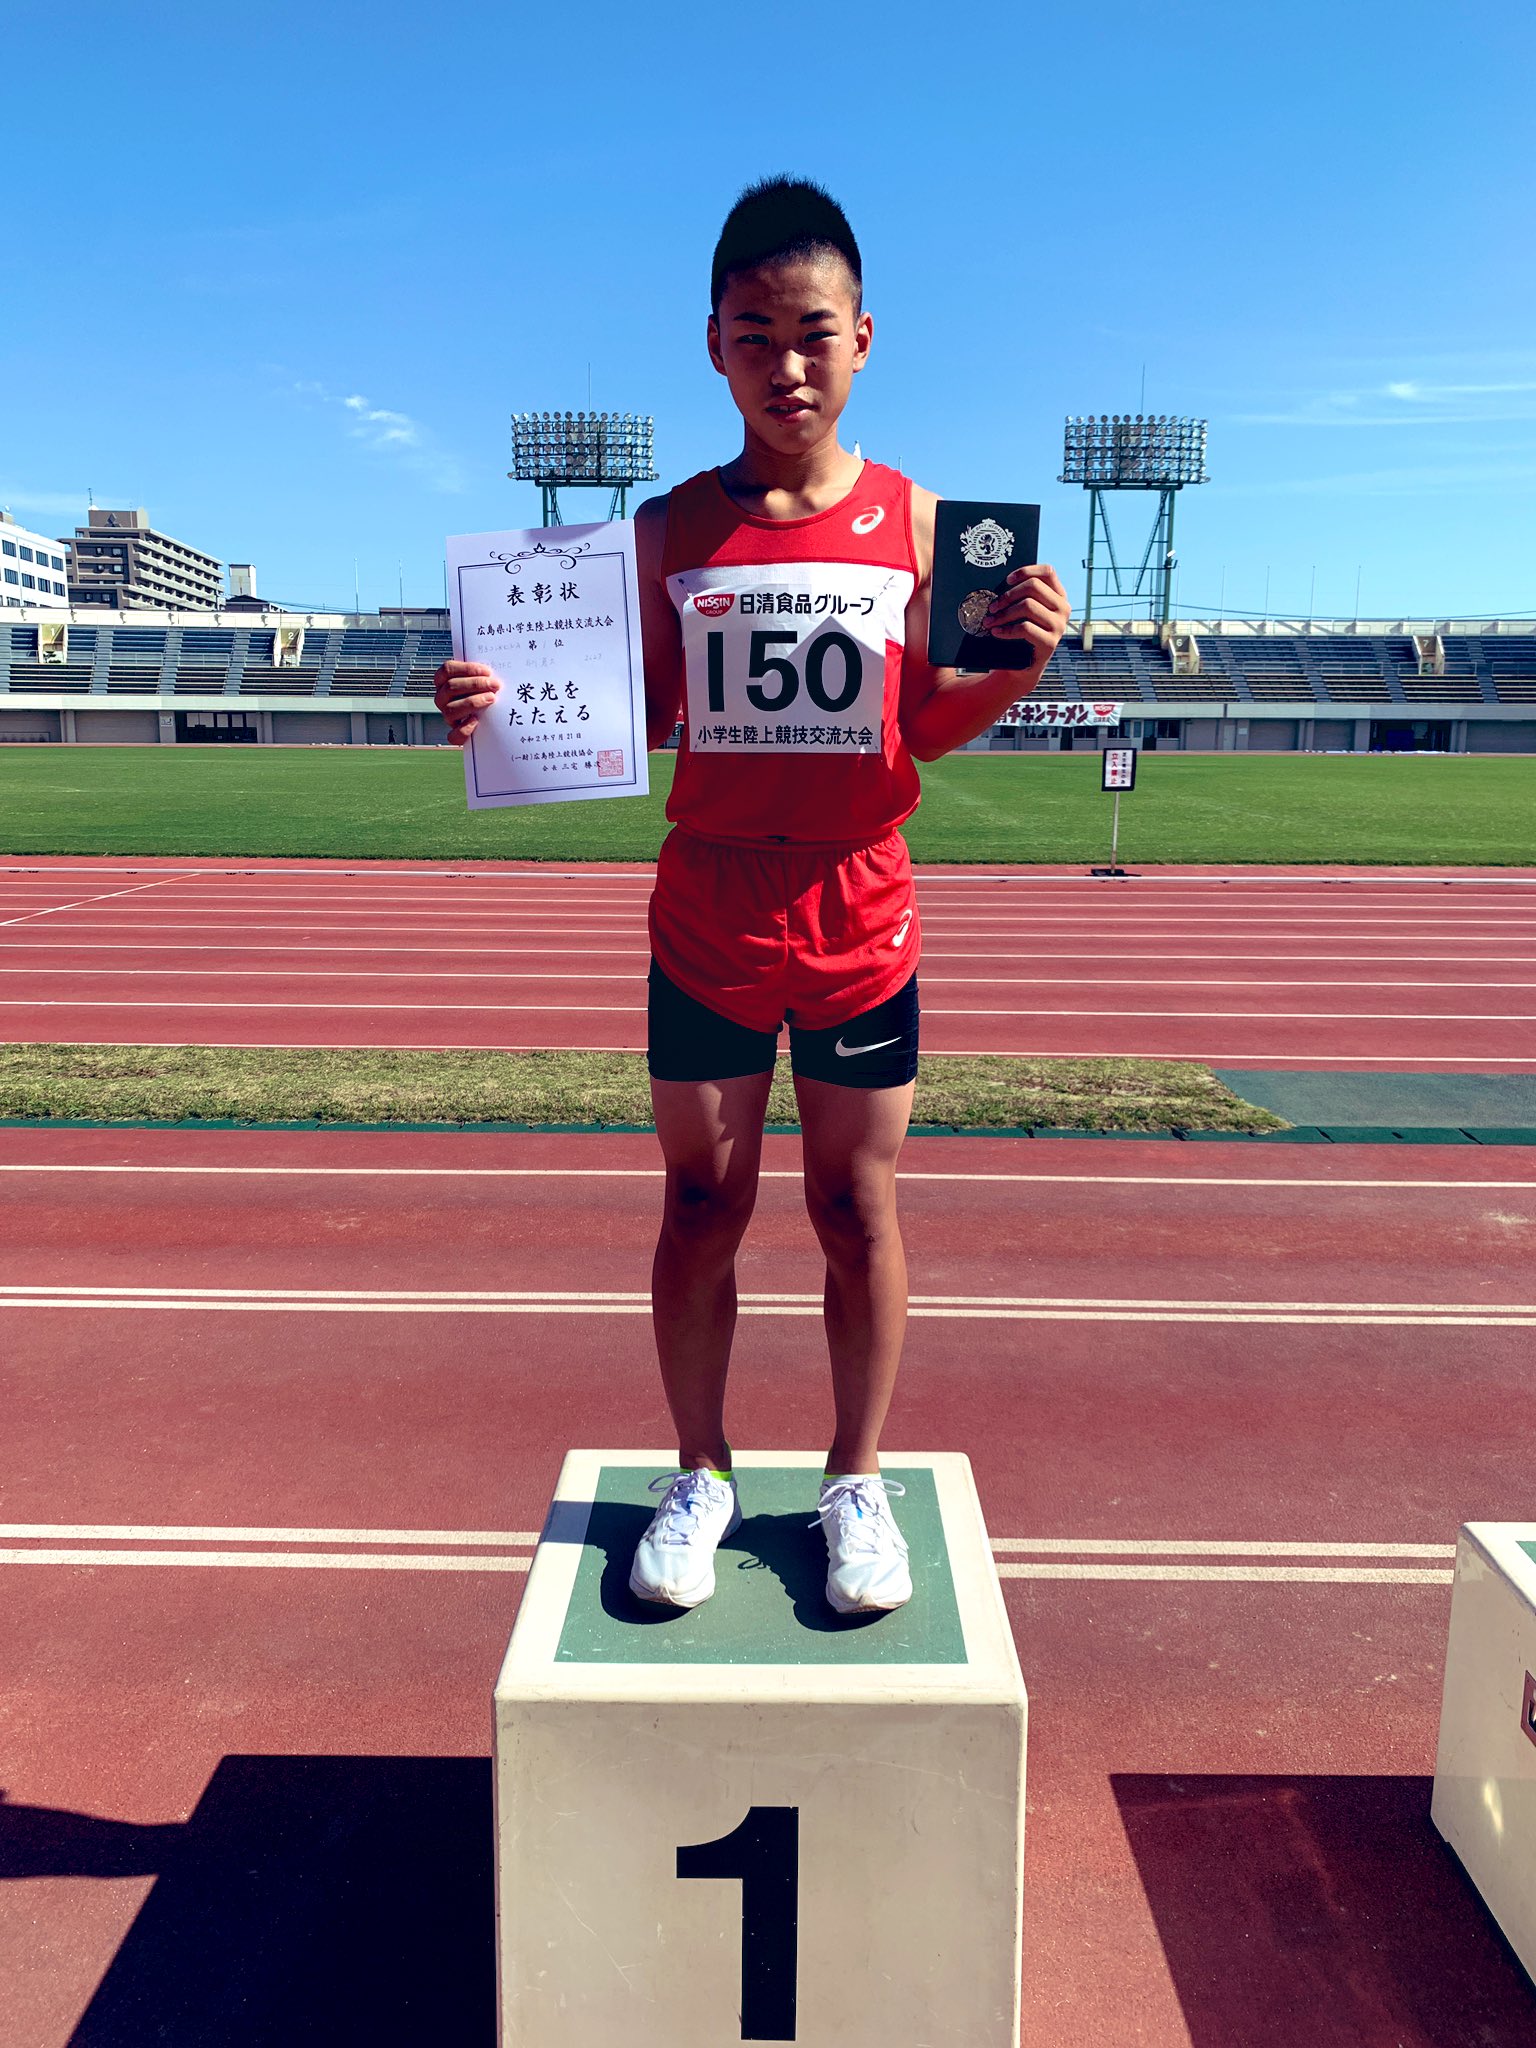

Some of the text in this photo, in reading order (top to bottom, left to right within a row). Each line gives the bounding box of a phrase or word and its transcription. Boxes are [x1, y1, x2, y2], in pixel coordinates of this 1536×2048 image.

[507, 581, 580, 606] 表彰状
[697, 596, 731, 609] NISSIN
[740, 592, 875, 616] 日清食品グループ
[288, 632, 294, 640] 2
[476, 615, 614, 636] 広島県小学生陸上競技交流大会
[1176, 639, 1182, 647] 6
[1423, 639, 1429, 647] 7
[707, 631, 863, 712] 150
[517, 680, 579, 704] 栄光を
[509, 704, 590, 726] たたえる
[520, 733, 582, 744] 令和2年9月21日
[698, 725, 874, 745] 小学生陸上競技交流大会
[676, 1806, 799, 2041] 1
